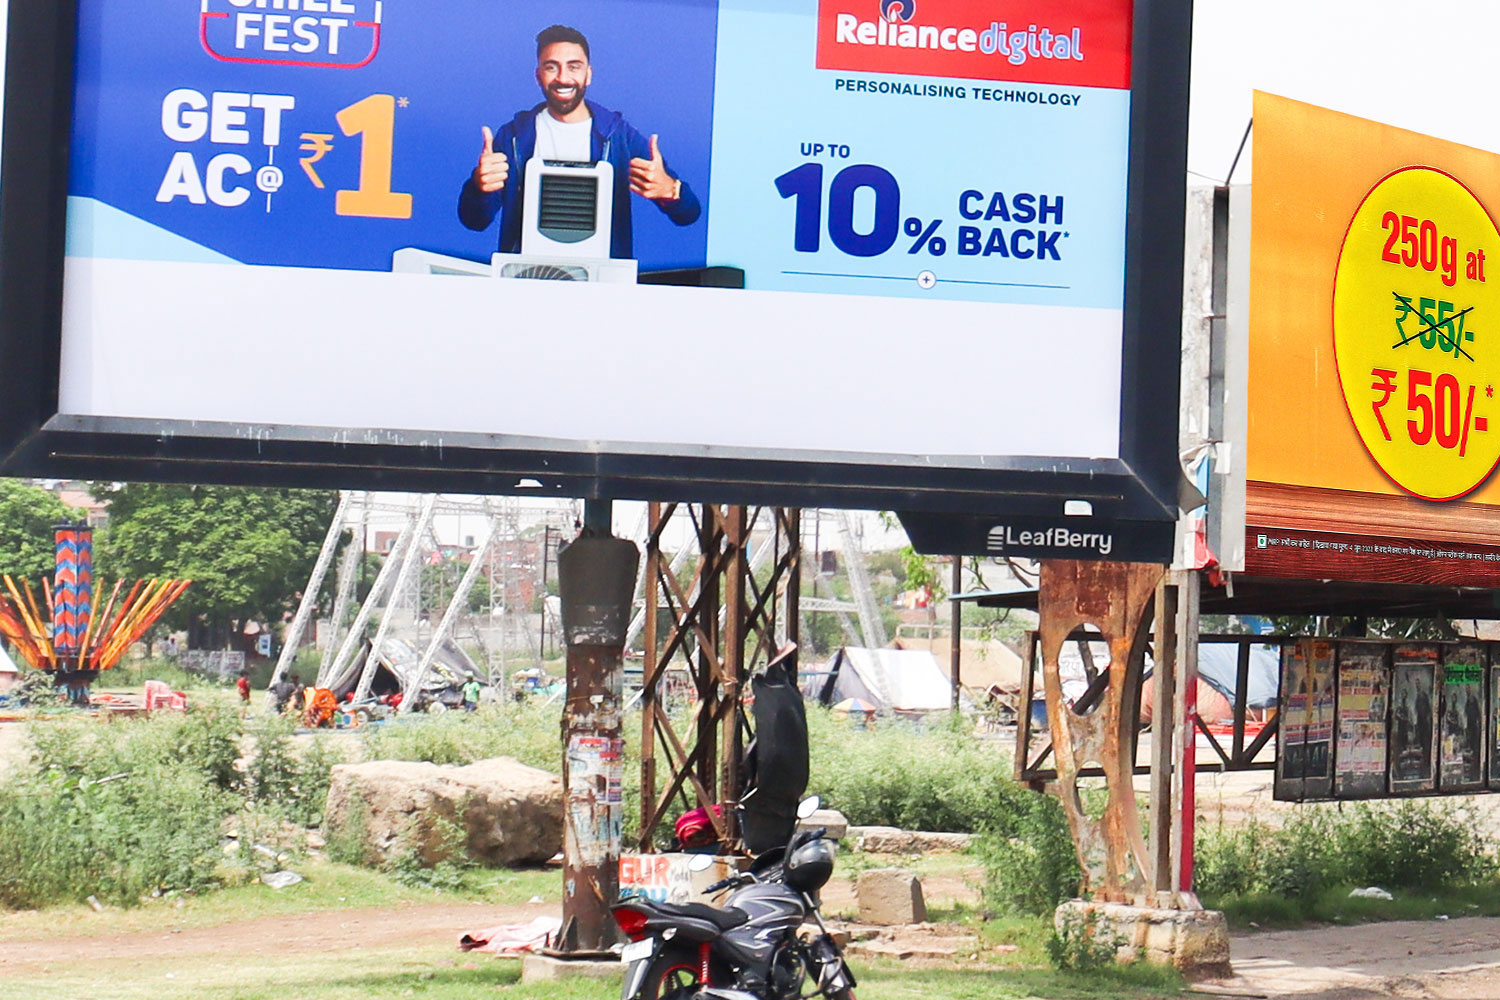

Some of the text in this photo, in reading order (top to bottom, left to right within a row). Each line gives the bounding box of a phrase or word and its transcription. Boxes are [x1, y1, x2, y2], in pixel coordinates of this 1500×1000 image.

[235, 12, 349, 54] FEST
[835, 79, 1082, 106] PERSONALISING TECHNOLOGY
[161, 88, 295, 146] GET
[800, 142, 850, 158] UP TO
[774, 162, 947, 257] 10%
[959, 190, 1064, 225] CASH
[1466, 249, 1486, 282] at
[1006, 526, 1112, 554] LeafBerry
[619, 856, 670, 886] GUR
